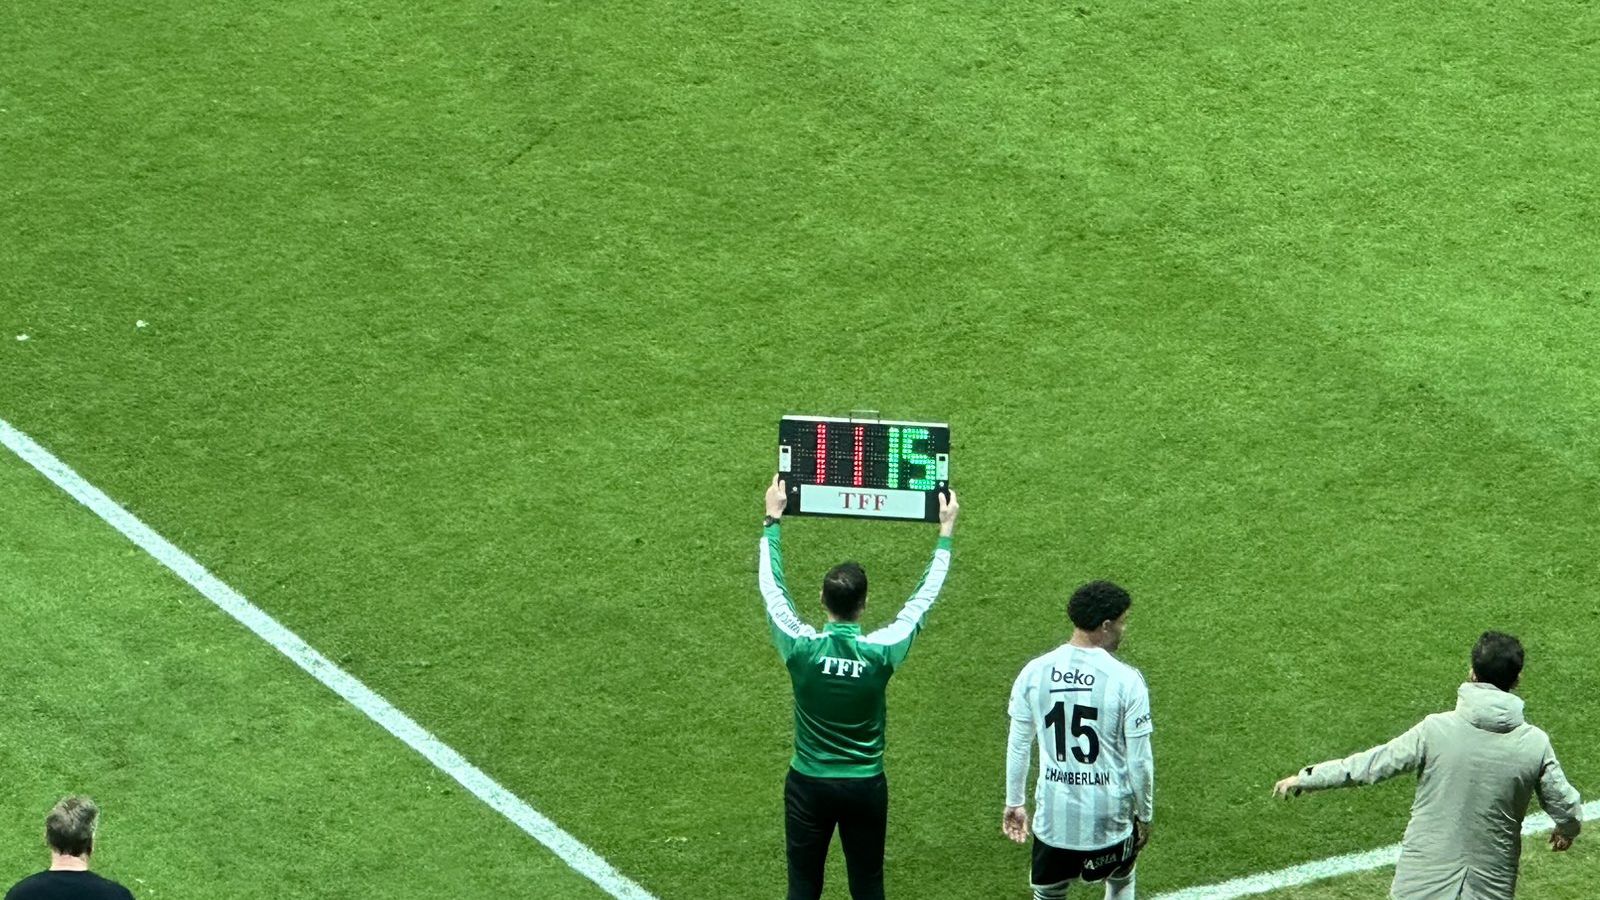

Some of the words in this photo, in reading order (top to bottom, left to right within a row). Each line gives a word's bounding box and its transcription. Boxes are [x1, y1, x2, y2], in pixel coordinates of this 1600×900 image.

[816, 424, 864, 488] 11
[888, 427, 936, 490] 15
[839, 492, 888, 511] TFF
[819, 656, 867, 678] TFF
[1051, 667, 1095, 686] beko
[1044, 701, 1100, 764] 15
[1045, 768, 1110, 785] CHAMBERLAIN
